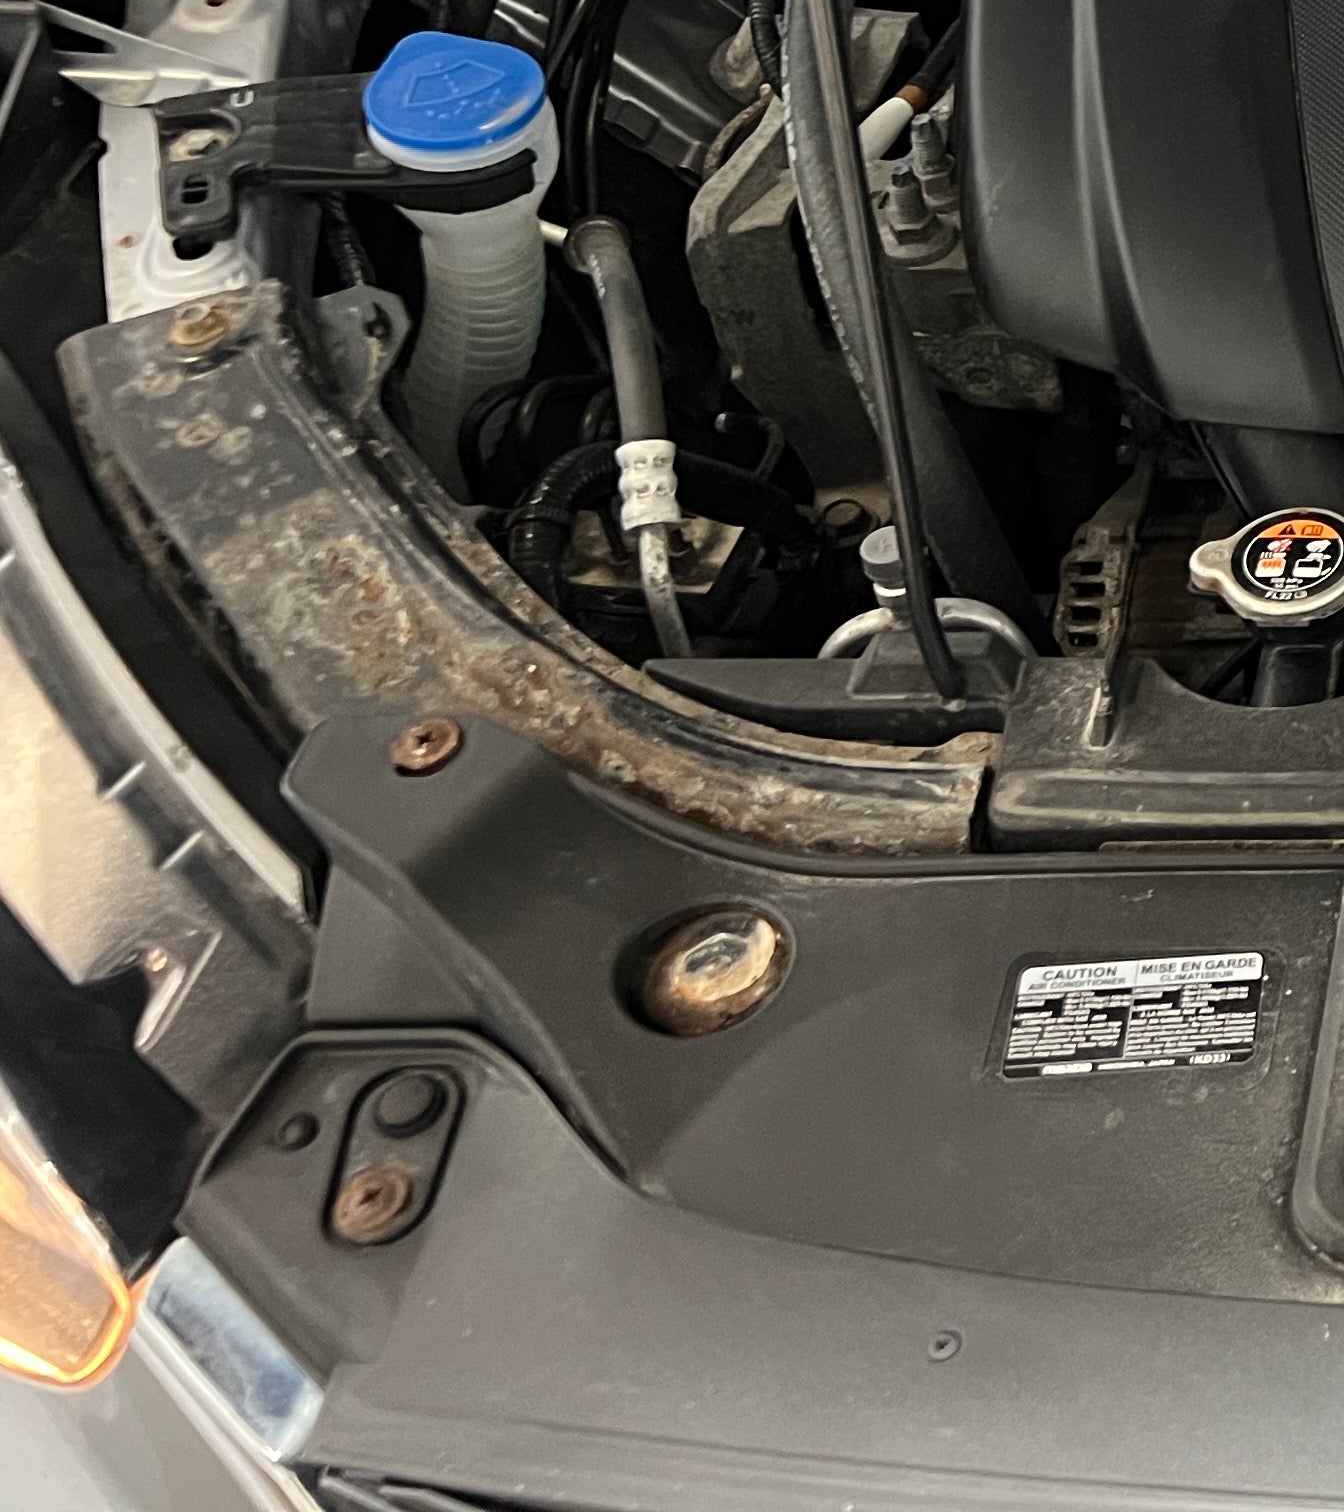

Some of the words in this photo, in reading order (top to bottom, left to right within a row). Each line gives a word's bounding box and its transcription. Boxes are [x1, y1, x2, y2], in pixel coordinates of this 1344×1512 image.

[1141, 962, 1177, 974] MISE
[1181, 961, 1202, 972] EN
[1205, 957, 1257, 970] GARDE
[1043, 966, 1118, 981] CAUTION
[1160, 970, 1234, 982] CLIMATISEUR
[1028, 982, 1047, 991] AIR
[1050, 977, 1126, 989] CONDITIONER
